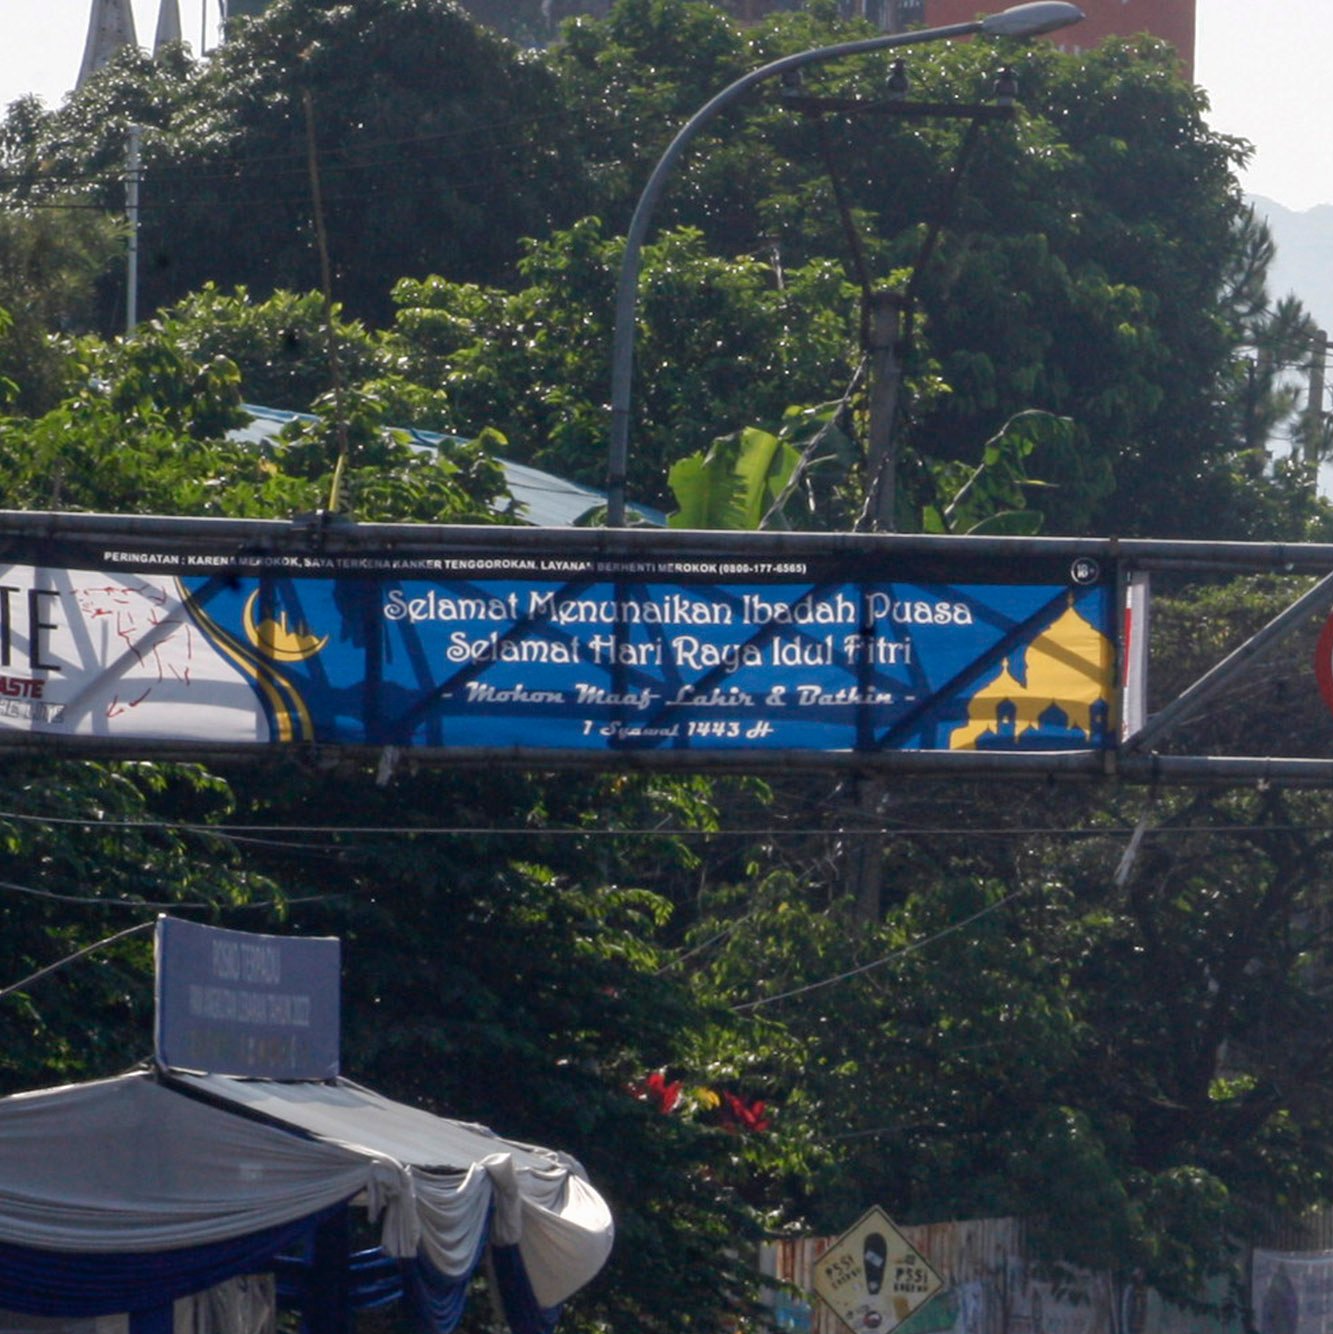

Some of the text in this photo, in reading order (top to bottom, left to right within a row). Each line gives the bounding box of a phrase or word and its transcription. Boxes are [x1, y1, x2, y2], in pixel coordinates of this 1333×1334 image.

[104, 552, 179, 565] PERINGATAN
[188, 555, 237, 567] KARENA
[304, 557, 335, 569] SAYA
[337, 558, 391, 569] TERKENA
[393, 559, 442, 570] KANKER
[597, 562, 656, 573] BERHENTI
[658, 563, 718, 574] MEROKOK
[384, 590, 974, 629] Selamat Menunaikan Ibadah Puasa
[446, 631, 912, 673] Selamat Hari Raya Idul Fitri
[466, 682, 565, 705] Mohon
[575, 683, 662, 710] Maaf
[666, 685, 756, 707] Lahir
[765, 685, 788, 706] &
[687, 722, 741, 737] 1443
